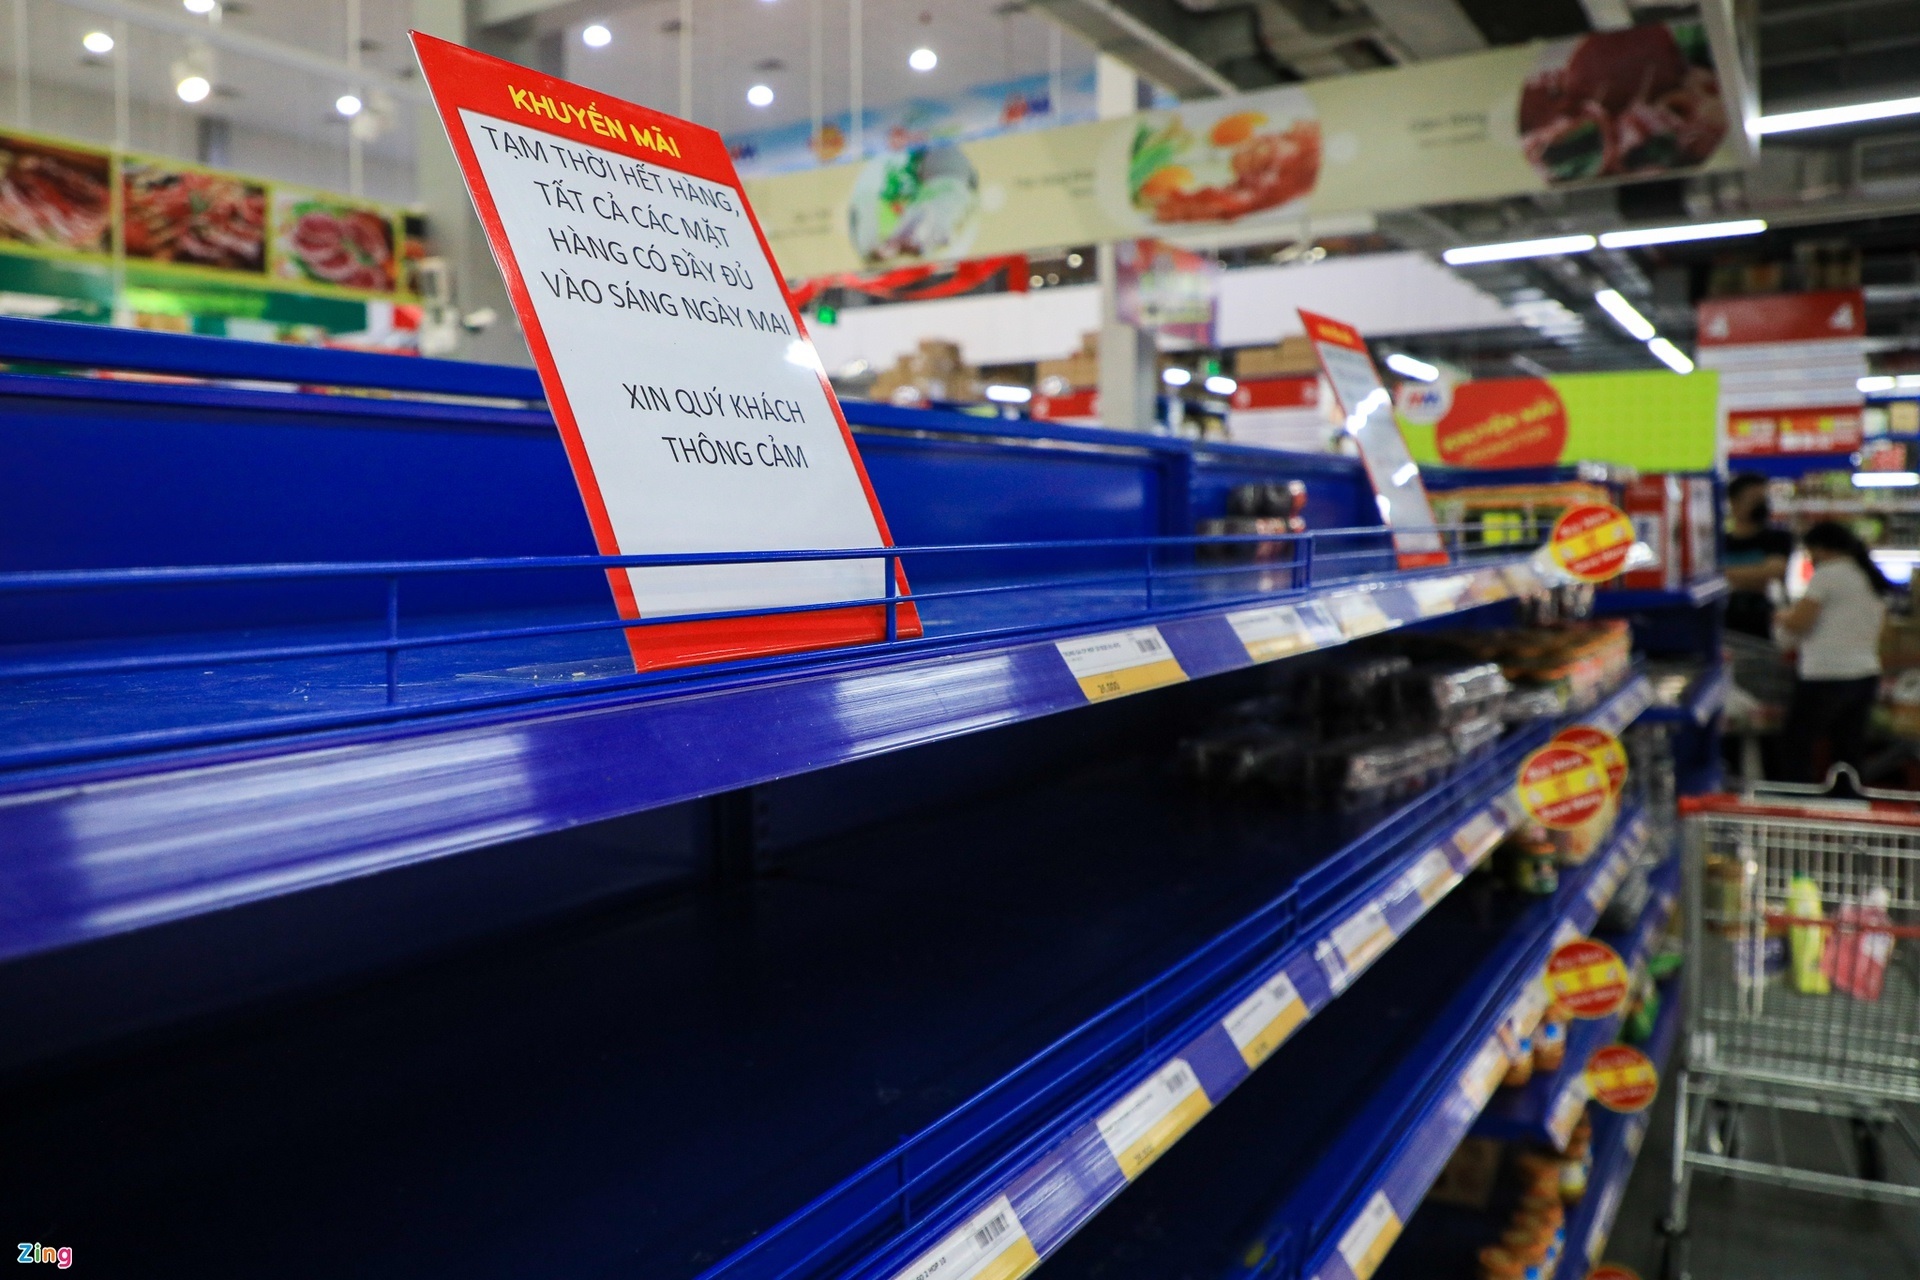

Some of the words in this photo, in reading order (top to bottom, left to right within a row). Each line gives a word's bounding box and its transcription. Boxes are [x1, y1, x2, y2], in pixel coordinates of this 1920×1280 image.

[507, 84, 628, 142] KHUYẾN
[629, 125, 682, 159] MÃI
[480, 125, 549, 164] TẠM
[550, 144, 617, 182] THỜI
[619, 163, 664, 194] HẾT
[668, 176, 740, 217] HÀNG,
[533, 179, 585, 214] TẤT
[592, 191, 629, 224] CẢ
[631, 204, 680, 235] CÁC
[680, 217, 730, 249] MẶT
[548, 225, 629, 265] HÀNG
[632, 244, 668, 273] CÓ
[671, 247, 717, 283] ĐẦY
[720, 260, 754, 290] ĐỦ
[541, 268, 603, 305] VÀO
[607, 280, 679, 317] SÁNG
[681, 296, 744, 328] NGÀY
[746, 308, 791, 336] MAI
[622, 383, 671, 412] XIN
[675, 386, 726, 418] QUÝ
[729, 392, 806, 424] KHÁCH
[661, 431, 754, 466] THÔNG
[757, 434, 809, 469] CẢM
